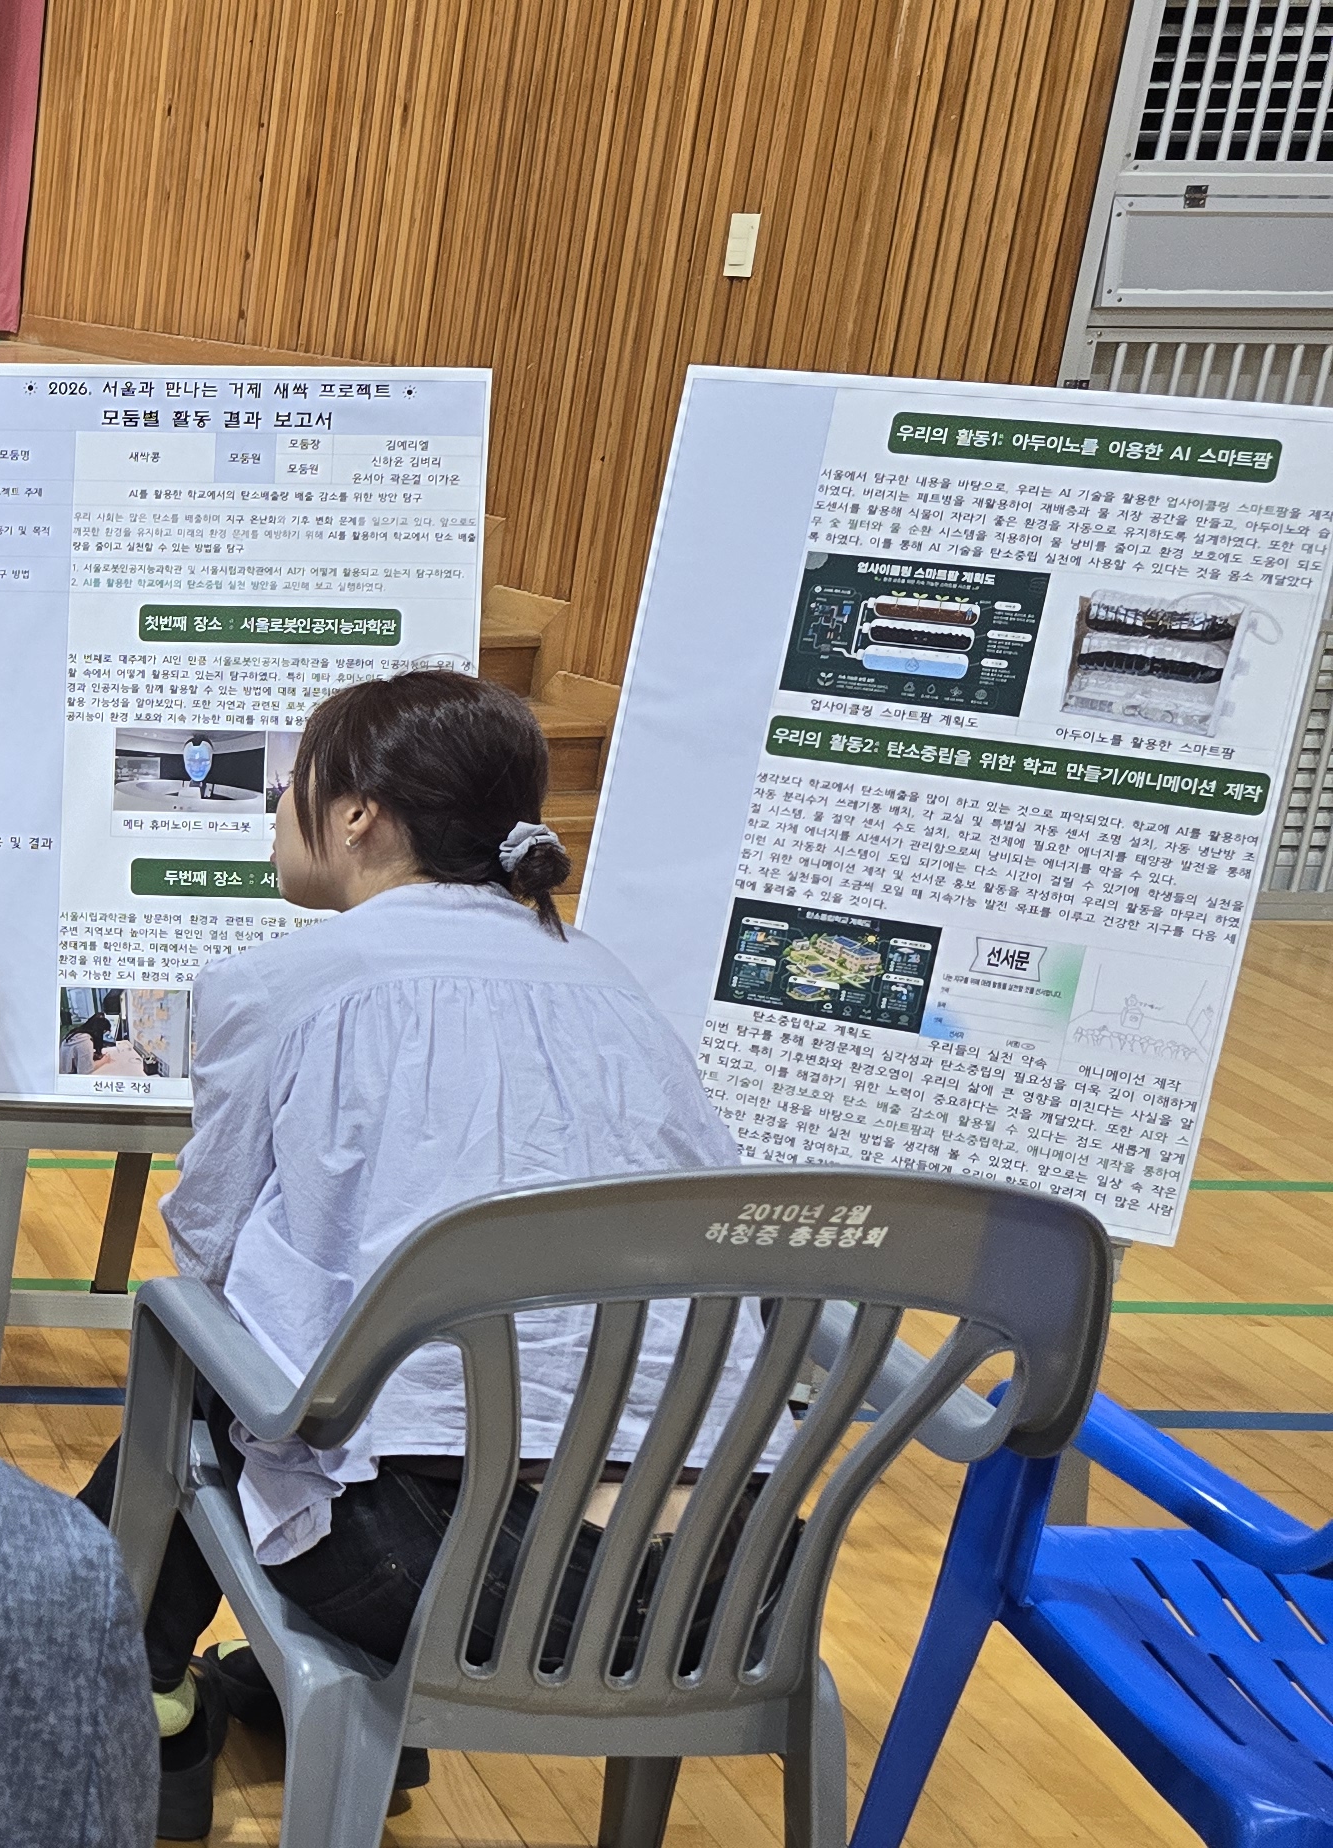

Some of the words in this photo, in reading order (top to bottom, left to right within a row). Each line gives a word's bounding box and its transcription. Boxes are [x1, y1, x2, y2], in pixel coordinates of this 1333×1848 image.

[47, 381, 92, 396] 2026.
[102, 380, 155, 398] 서울과
[165, 381, 218, 399] 만나는
[228, 381, 262, 399] 거제
[273, 382, 309, 400] 새싹
[318, 383, 391, 400] 프로젝트
[100, 409, 160, 428] 모둠별
[171, 409, 212, 429] 활동
[223, 410, 262, 430] 결과
[273, 411, 333, 431] 보고서
[287, 438, 321, 451] 모둠장
[896, 424, 949, 445] 우리의
[1011, 433, 1100, 456] 아두이노를
[1108, 440, 1164, 461] 이용한
[1168, 445, 1192, 461] AI
[1196, 447, 1274, 470] 스마트팜
[128, 451, 161, 463] 새싹콩
[227, 452, 261, 465] 모둠원
[286, 463, 319, 475] 모둠원
[17, 525, 27, 536] 및
[32, 525, 50, 536] 목적
[11, 569, 30, 580] 방법
[144, 615, 188, 632] 첫번째
[193, 615, 223, 632] 장소
[240, 616, 397, 635] 서울로봇인공지능과학관
[810, 698, 873, 718] 업사이클링
[879, 707, 933, 724] 스마트팜
[938, 713, 979, 728] 계획도
[1055, 727, 1124, 747] 아두이노를
[1130, 736, 1173, 753] 활용한
[1178, 742, 1236, 760] 스마트팜
[772, 727, 822, 749] 우리의
[886, 741, 972, 767] 탄소중립을
[978, 752, 1016, 772] 위한
[1022, 756, 1058, 776] 학교
[1065, 762, 1217, 797] 만들기/애니메이션
[1222, 782, 1263, 803] 제작
[122, 818, 144, 830] 메타
[148, 819, 203, 832] 휴머노이드
[208, 820, 252, 833] 마스크봇
[9, 836, 21, 850] 및
[28, 836, 53, 850] 결과
[164, 870, 207, 886] 두번째
[213, 870, 243, 887] 장소
[986, 945, 1031, 972] 선서문
[752, 1010, 827, 1032] 탄소중립학교
[833, 1024, 872, 1040] 계획도
[927, 1039, 981, 1059] 우리들의
[987, 1049, 1013, 1065] 실천
[1020, 1054, 1048, 1070] 약속
[704, 1019, 729, 1034] 이번
[736, 1024, 773, 1042] 탐구를
[779, 1032, 805, 1047] 통해
[810, 1037, 874, 1059] 환경문제의
[881, 1049, 934, 1069] 심각성과
[940, 1059, 1006, 1081] 탄소중립의
[1013, 1071, 1067, 1091] 필요성을
[1073, 1081, 1101, 1097] 더욱
[1107, 1087, 1135, 1103] 깊이
[1142, 1093, 1198, 1113] 이해하게
[92, 1080, 126, 1093] 선서문
[129, 1081, 151, 1094] 작성
[1078, 1064, 1146, 1087] 애니메이션
[1152, 1076, 1182, 1093] 제작
[737, 1202, 825, 1224] 2010년
[827, 1204, 872, 1225] 2월
[704, 1222, 781, 1246] 하청중
[788, 1225, 889, 1248] 총동창회
